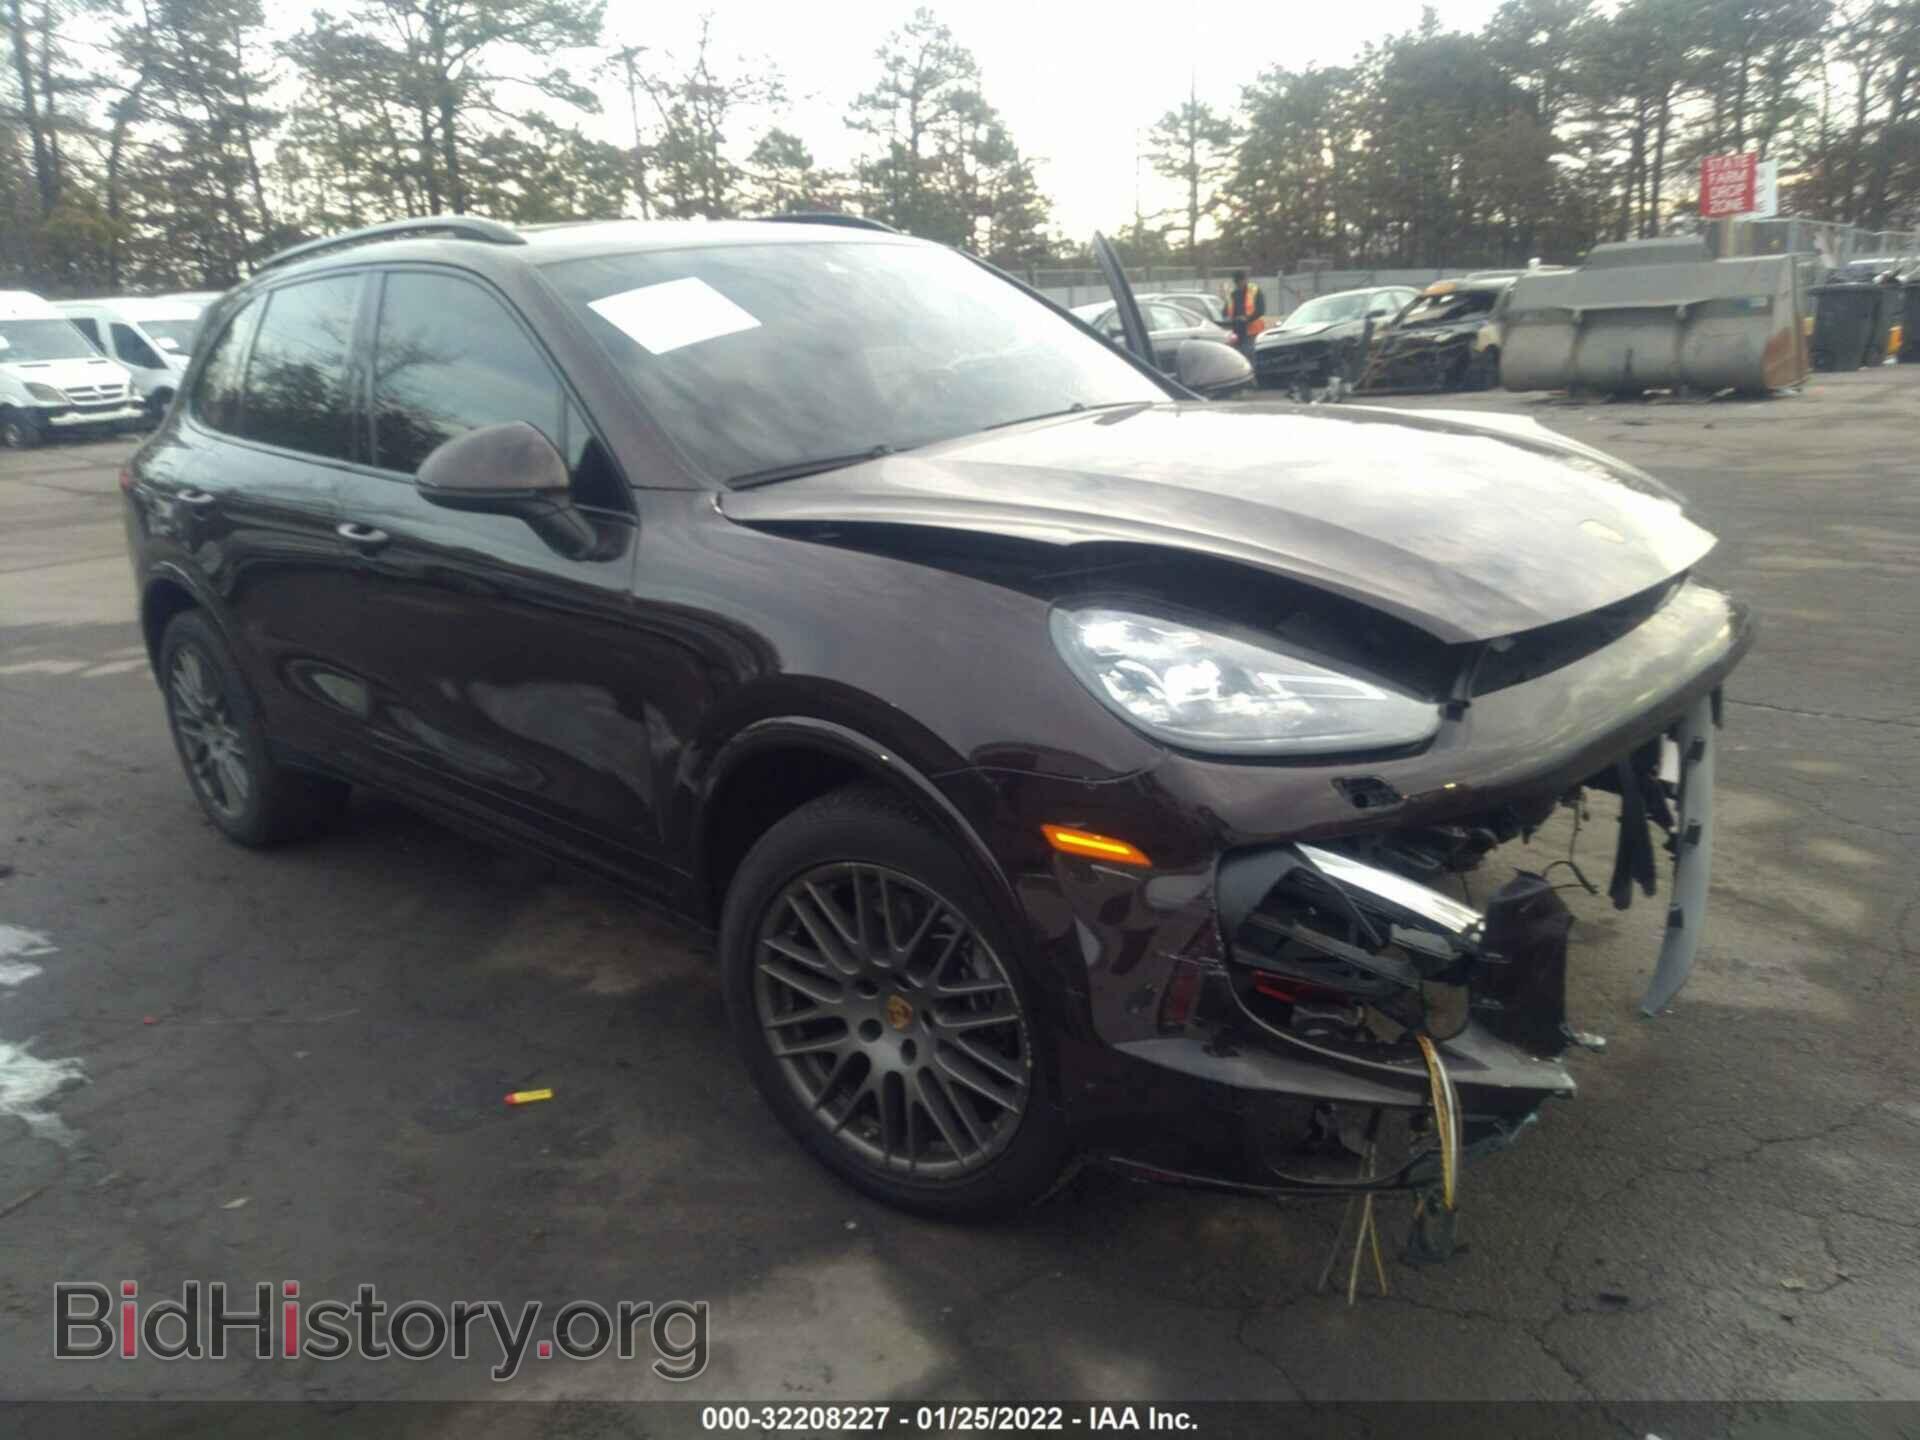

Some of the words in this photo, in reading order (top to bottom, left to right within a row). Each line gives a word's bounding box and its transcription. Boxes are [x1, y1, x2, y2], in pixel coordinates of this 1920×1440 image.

[1706, 154, 1750, 172] STATE
[1707, 169, 1748, 185] FARM
[1709, 184, 1746, 200] DROP
[1709, 198, 1745, 214] ZONE
